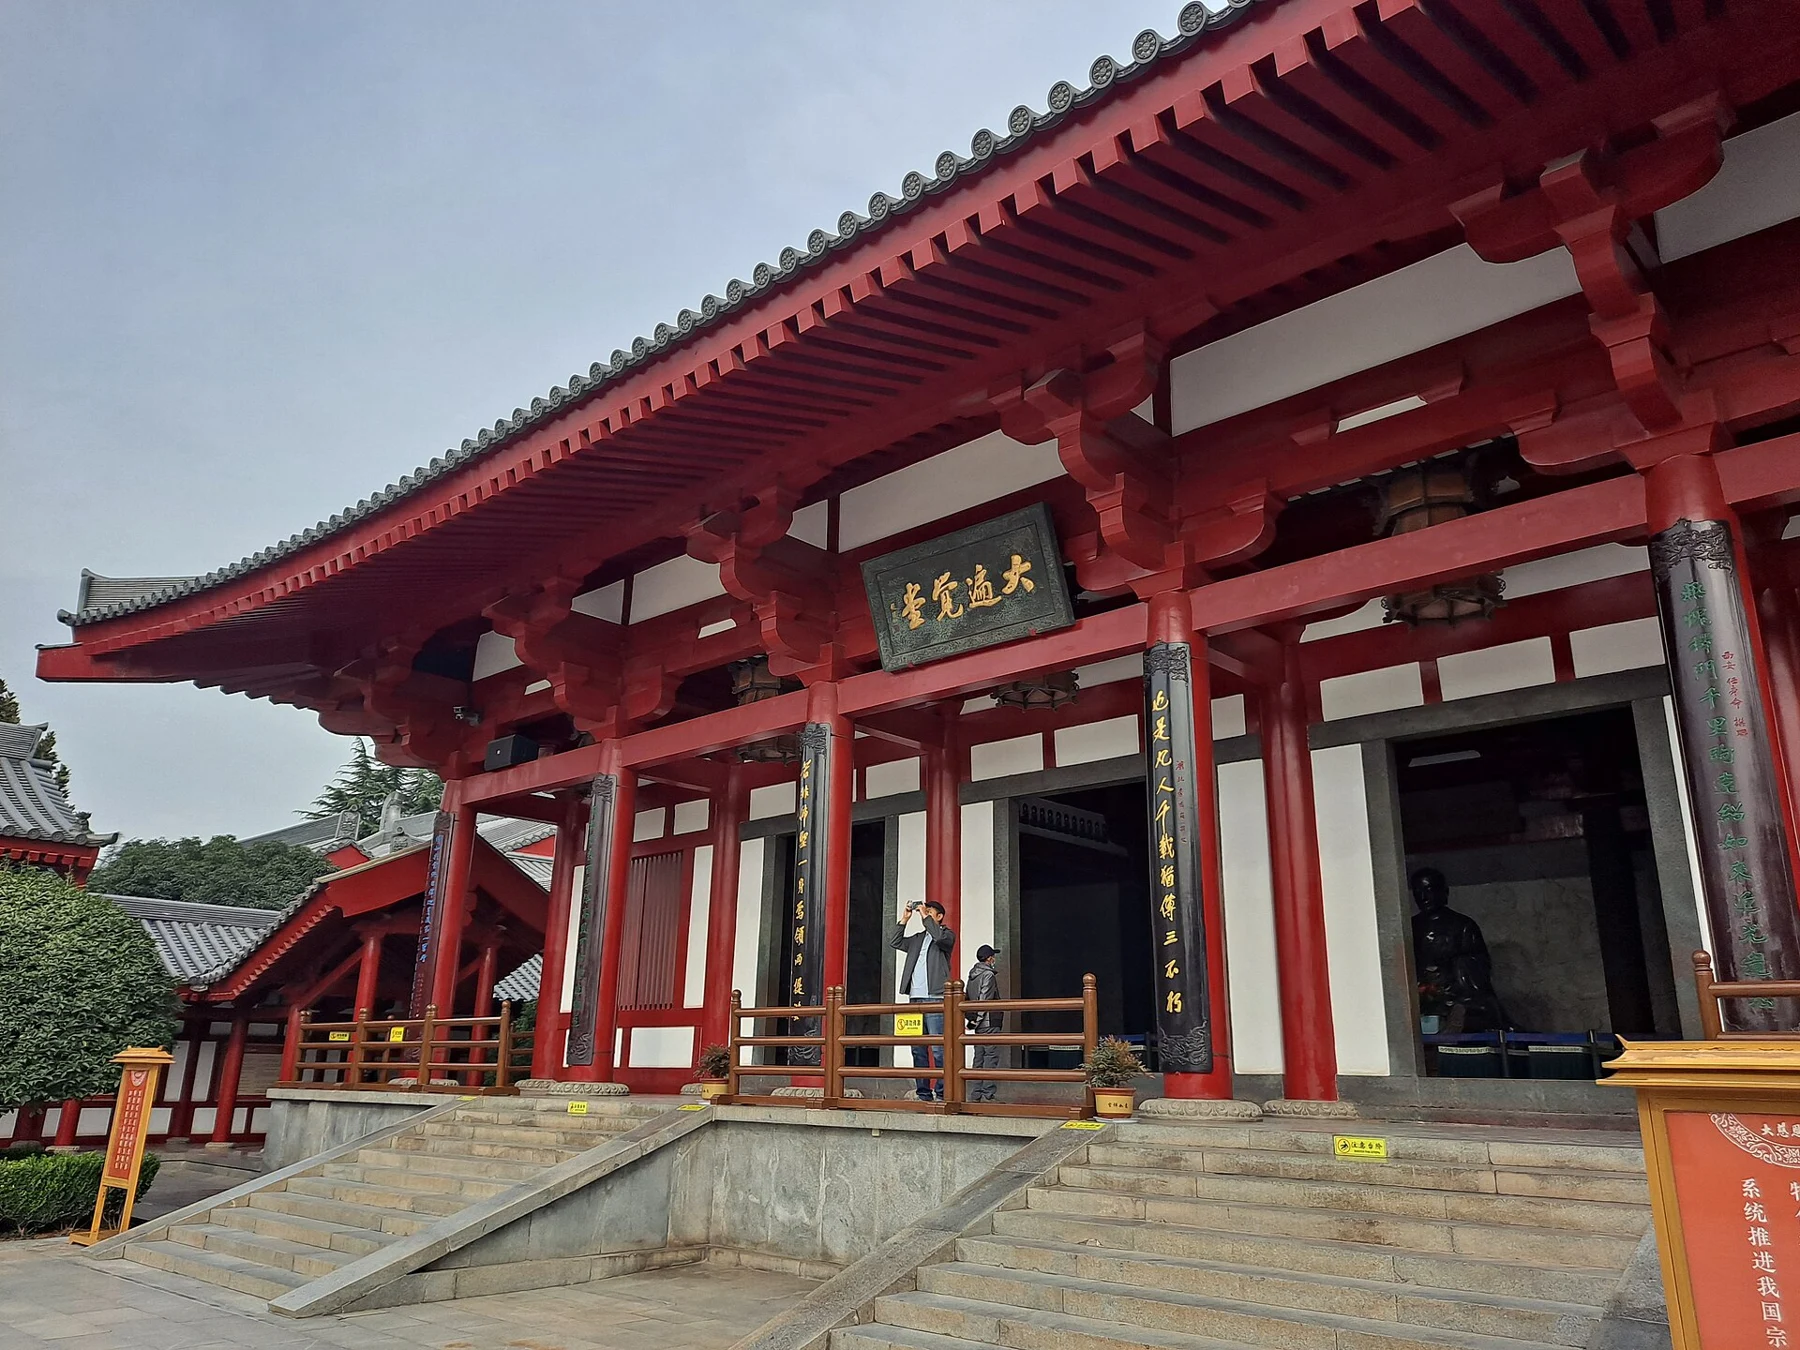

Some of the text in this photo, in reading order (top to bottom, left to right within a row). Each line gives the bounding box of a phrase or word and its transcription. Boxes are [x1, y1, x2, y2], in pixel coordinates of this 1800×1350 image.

[1741, 1176, 1788, 1349] 系统推进我国宗
